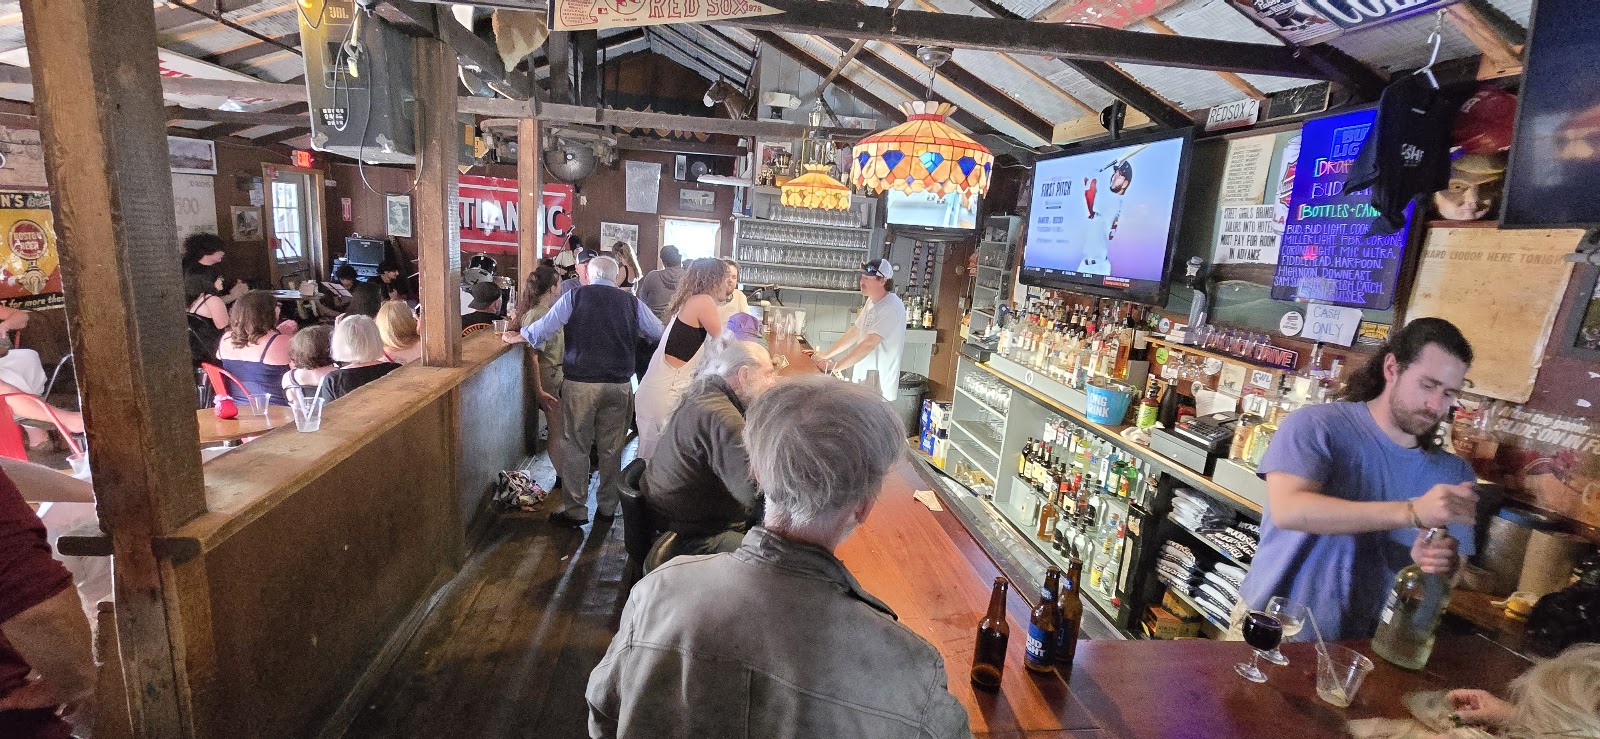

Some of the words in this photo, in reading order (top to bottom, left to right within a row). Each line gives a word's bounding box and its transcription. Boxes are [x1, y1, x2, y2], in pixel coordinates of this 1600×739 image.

[1342, 127, 1370, 143] BU
[1333, 142, 1361, 158] LIG
[1041, 182, 1056, 198] FIRST
[1056, 181, 1072, 196] PITCH
[0, 194, 25, 208] N'S
[459, 197, 566, 237] TLANIC
[1234, 234, 1246, 247] PAY
[1246, 235, 1258, 247] FOR
[1486, 252, 1516, 262] HERE
[1313, 305, 1341, 321] CASH
[1312, 321, 1344, 338] ONLY
[1537, 428, 1564, 445] ON
[1027, 633, 1043, 648] UD
